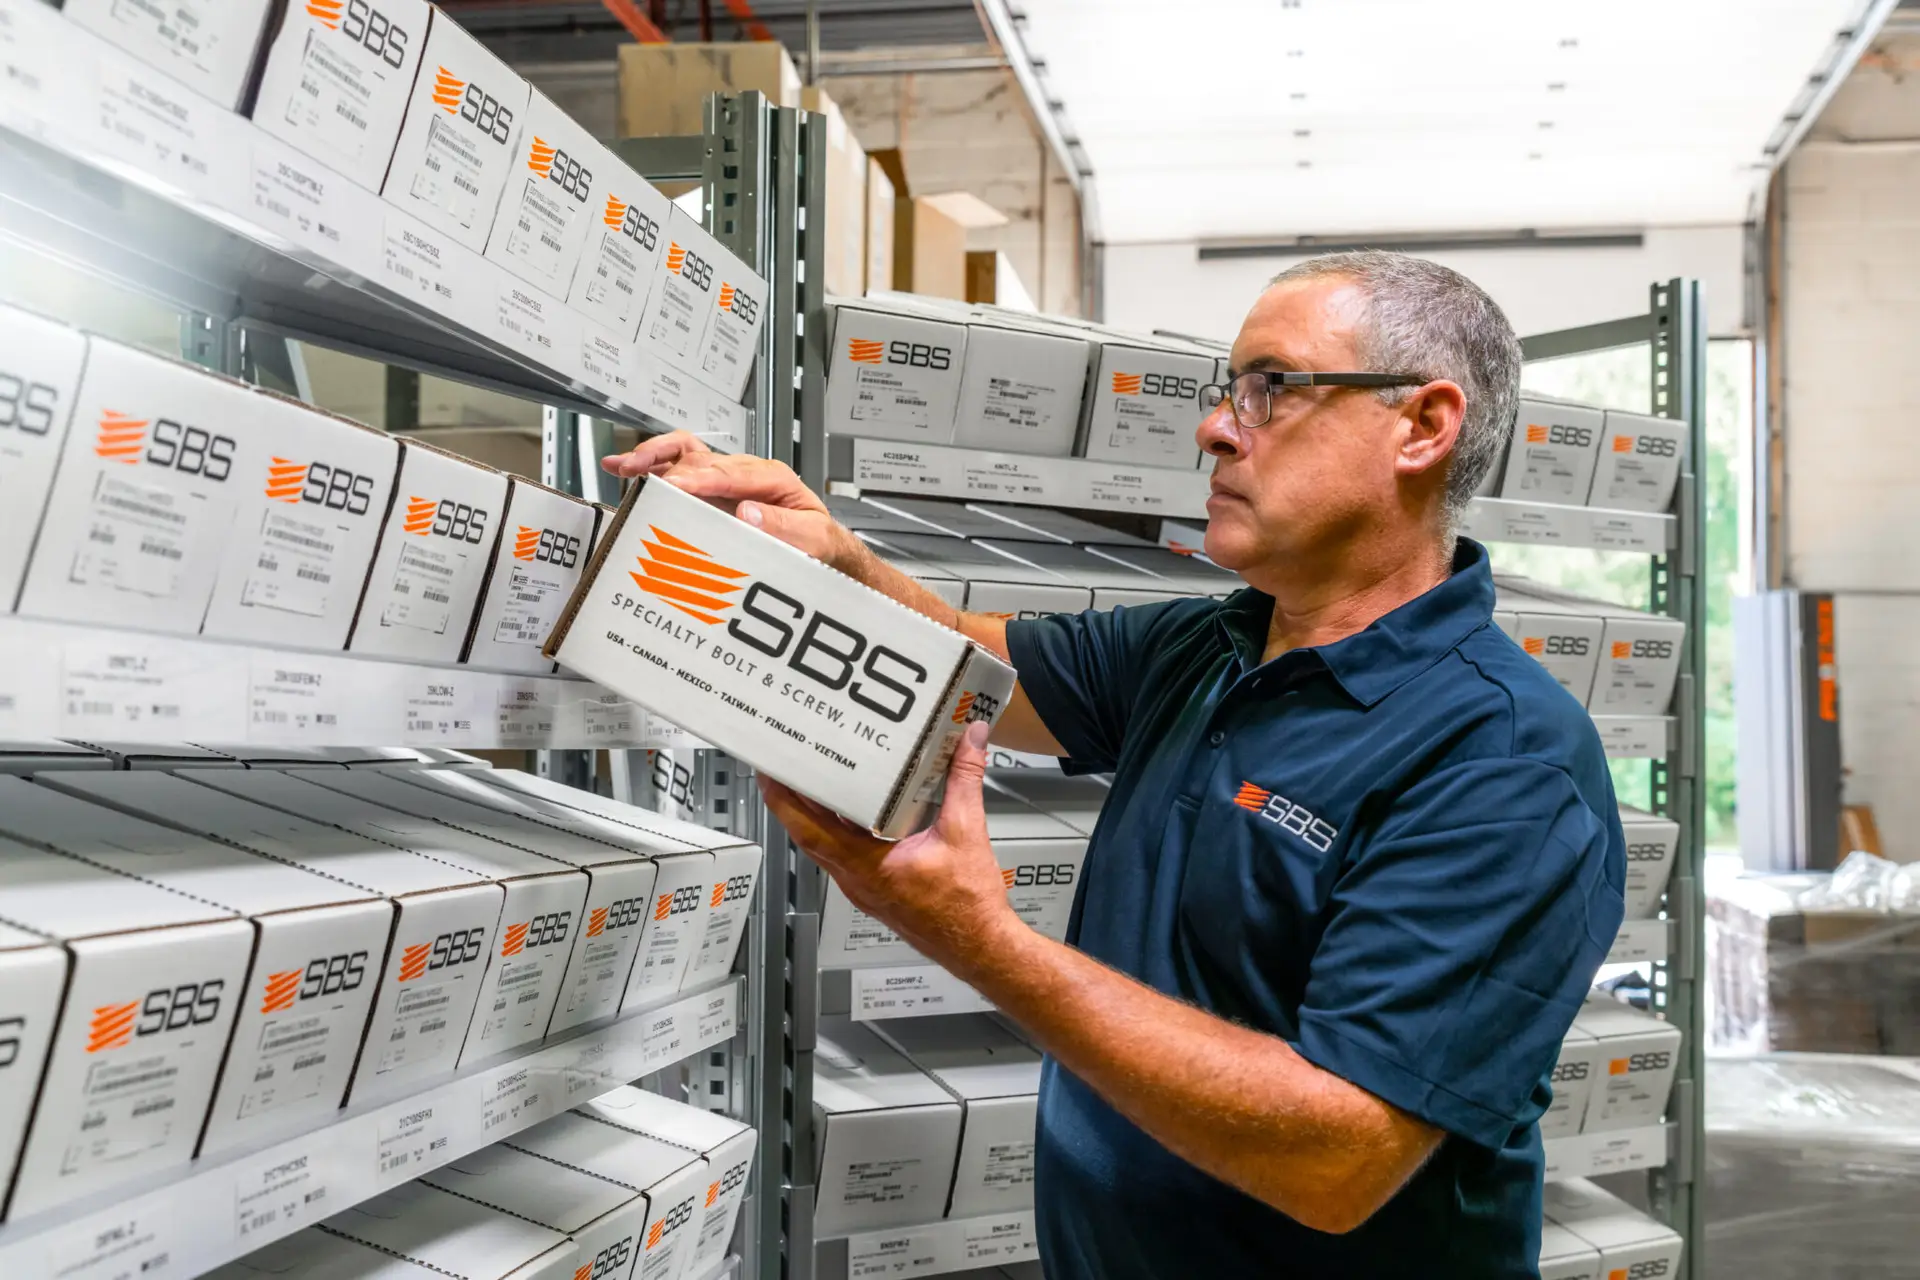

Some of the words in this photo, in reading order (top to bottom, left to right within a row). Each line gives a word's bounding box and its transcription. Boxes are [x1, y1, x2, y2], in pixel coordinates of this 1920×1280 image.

[343, 0, 408, 69] SBS
[461, 83, 513, 145] SBS
[550, 149, 593, 203] SBS
[623, 205, 659, 252] SBS
[682, 251, 713, 292] SBS
[731, 287, 758, 326] SBS
[888, 341, 951, 370] SBS
[0, 371, 58, 436] BS
[1142, 373, 1198, 399] SBS
[147, 418, 236, 482] SBS
[1549, 424, 1592, 447] SBS
[1636, 435, 1677, 458] SBS
[302, 461, 374, 516] SBS
[432, 499, 487, 545] SBS
[536, 528, 580, 569] SBS
[728, 581, 927, 723] SBS
[1546, 635, 1590, 656] SBS
[1632, 640, 1673, 659] SBS
[611, 593, 707, 650] SPECIALTY
[711, 645, 757, 677] BOLT
[762, 673, 774, 688] &
[781, 683, 846, 728] SCREW,
[854, 721, 891, 751] INC.
[606, 631, 625, 646] USA
[632, 645, 668, 670] CANADA
[676, 668, 712, 693] MEXICO
[720, 692, 757, 718] TAIWAN
[764, 716, 806, 743] FINLAND
[814, 742, 856, 771] VIETNAM
[1261, 795, 1338, 852] SBS
[1627, 843, 1667, 862] SBS
[724, 874, 751, 902] SBS
[1015, 864, 1075, 887] SBS
[606, 897, 643, 930] SBS
[670, 885, 702, 915] SBS
[428, 927, 485, 970] SBS
[526, 911, 571, 948] SBS
[300, 950, 368, 1001] SBS
[136, 979, 225, 1037] SBS
[1628, 1052, 1670, 1072] SBS
[719, 1160, 748, 1196] SBS
[662, 1195, 695, 1237] SBS
[591, 1235, 632, 1280] SBS
[1628, 1258, 1669, 1280] SBS
